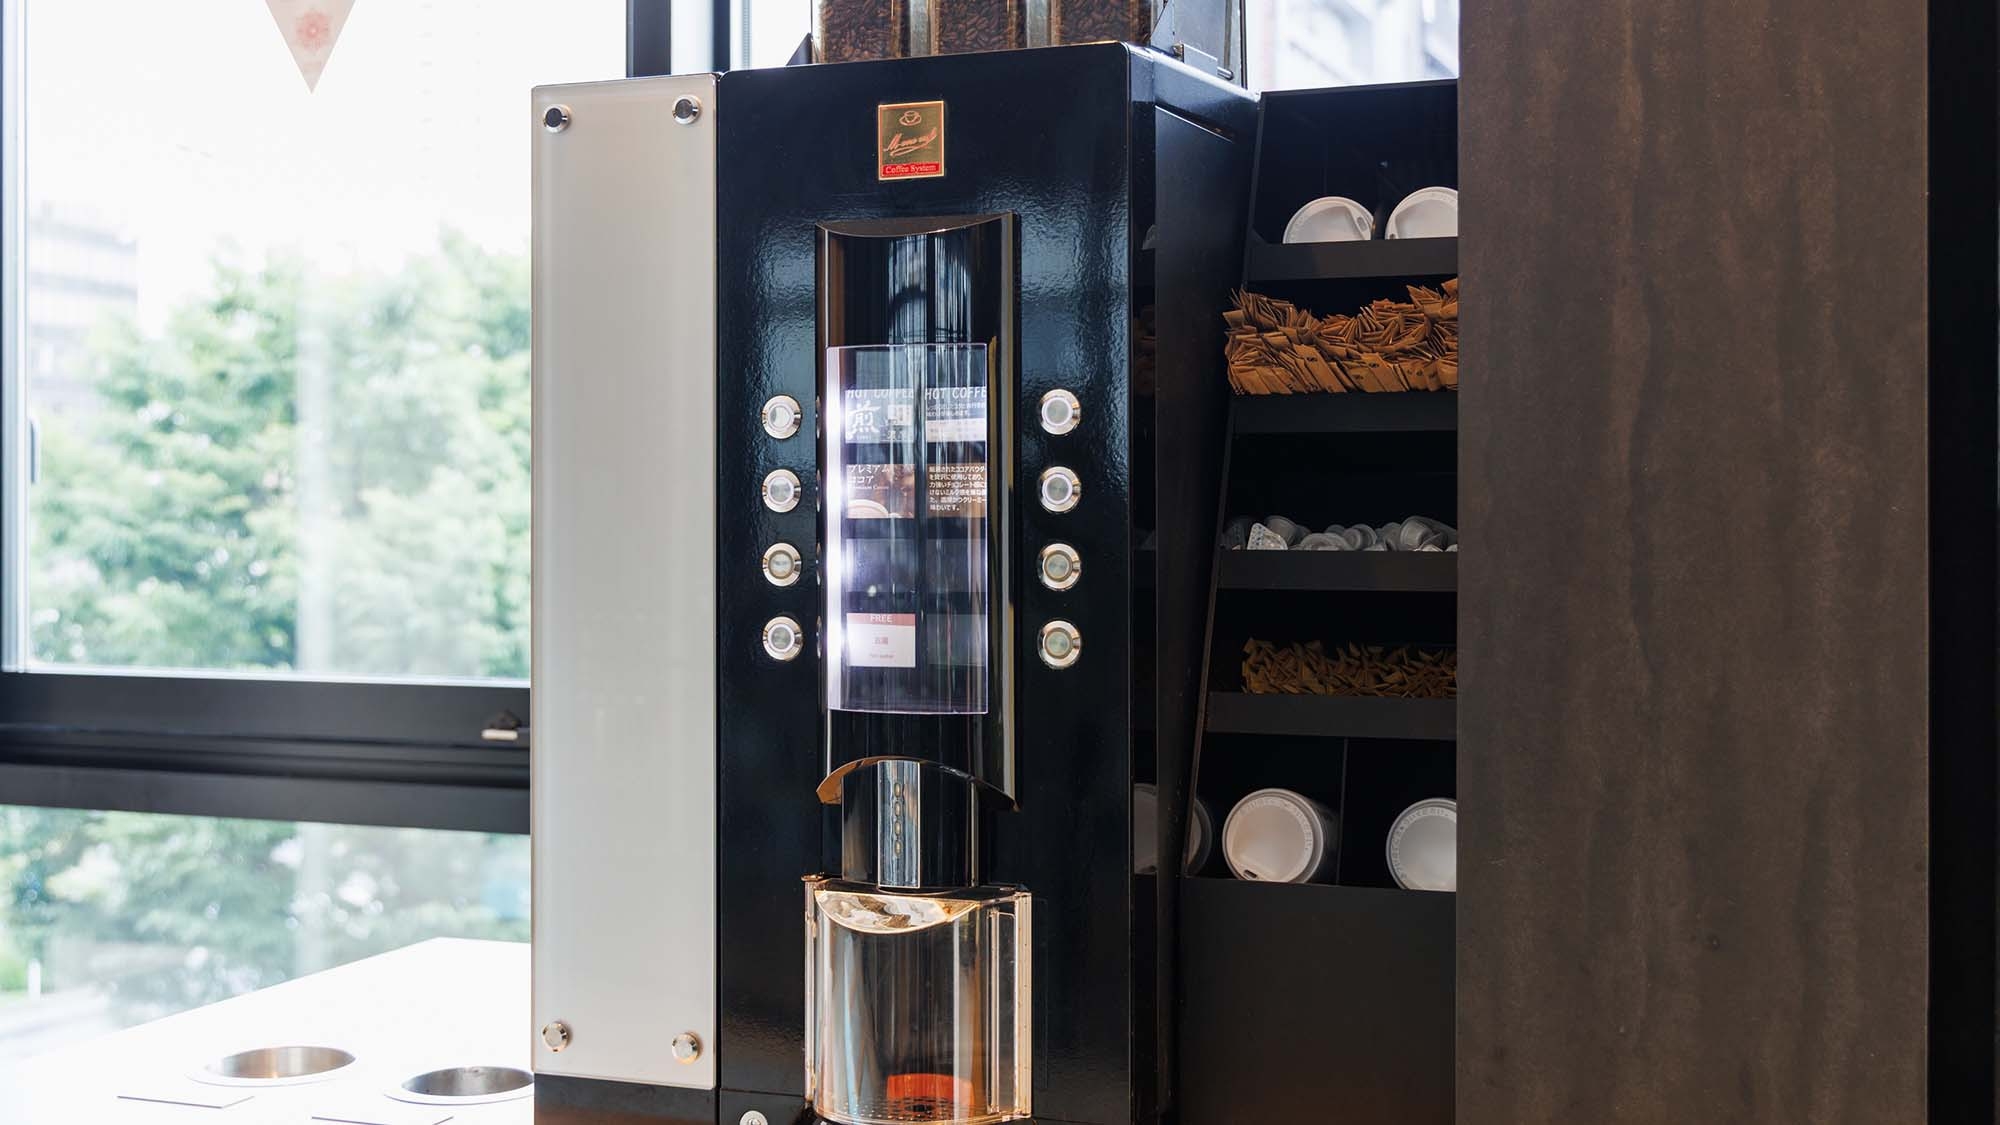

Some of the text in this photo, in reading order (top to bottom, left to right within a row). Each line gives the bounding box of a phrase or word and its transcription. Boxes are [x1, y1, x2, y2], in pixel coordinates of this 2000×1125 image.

[885, 164, 936, 174] Coffee System
[925, 387, 945, 400] HOT
[848, 464, 890, 473] プレミアム
[848, 475, 874, 484] ココア
[870, 615, 893, 623] FREE
